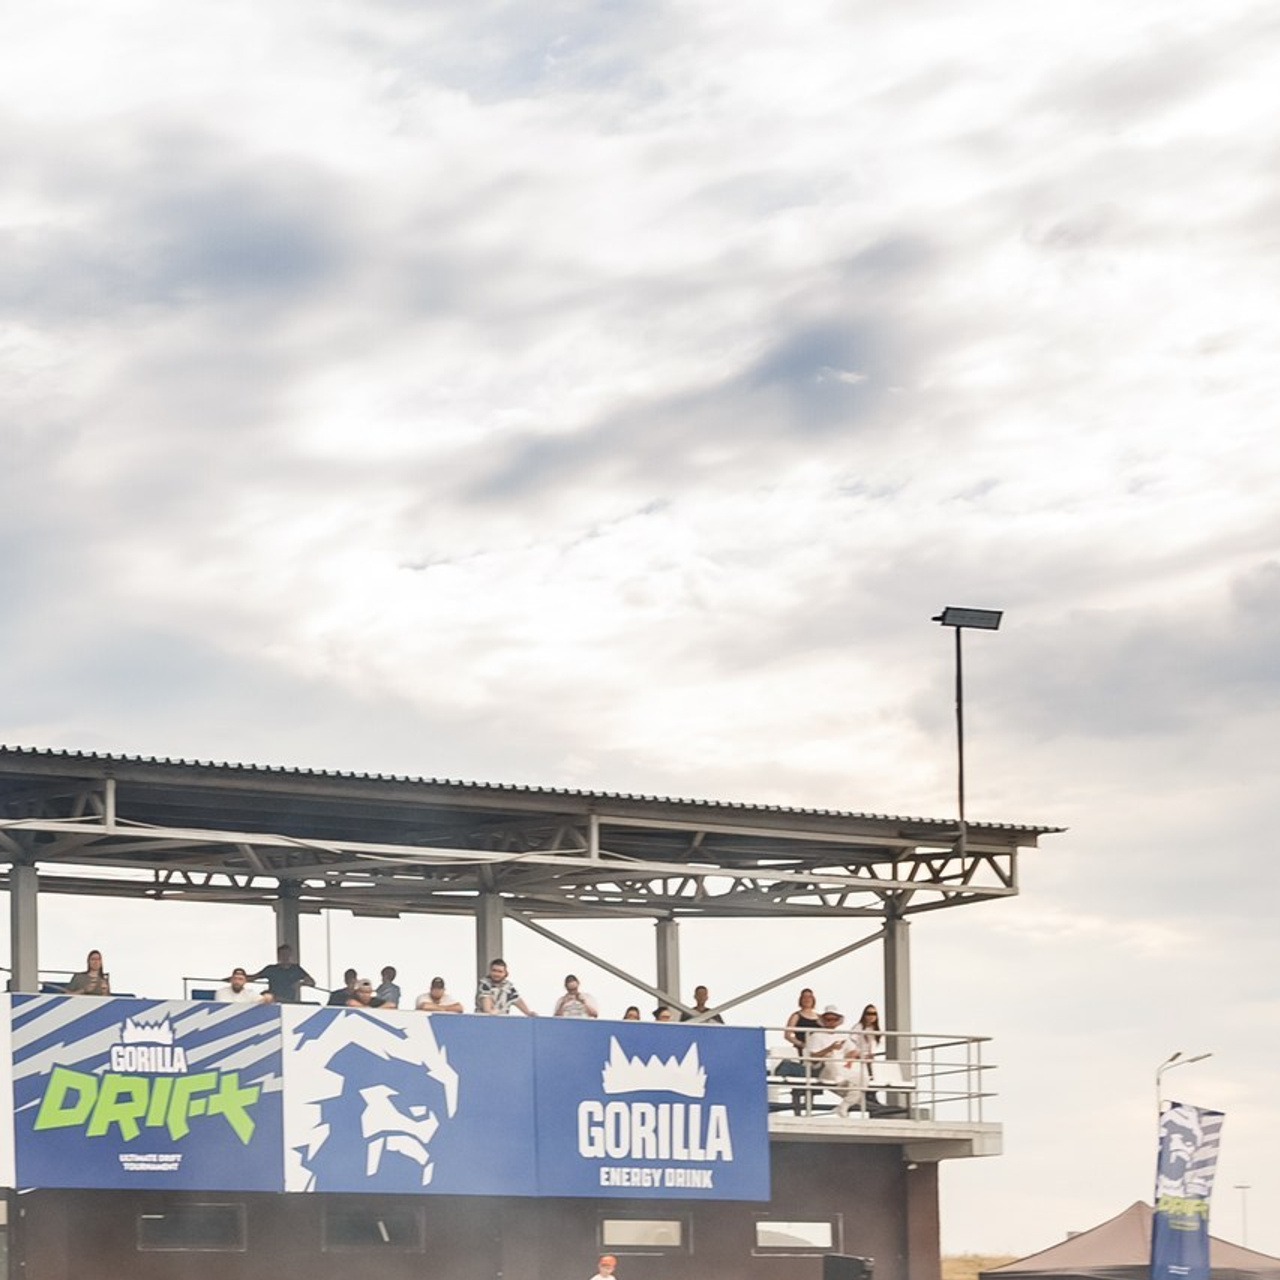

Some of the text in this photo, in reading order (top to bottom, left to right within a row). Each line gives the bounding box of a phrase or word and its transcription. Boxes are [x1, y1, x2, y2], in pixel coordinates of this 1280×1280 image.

[111, 1046, 188, 1073] GORILLA
[33, 1066, 261, 1146] DRIFT
[577, 1100, 734, 1161] GORILLA
[600, 1167, 713, 1189] ENERGY DRINK
